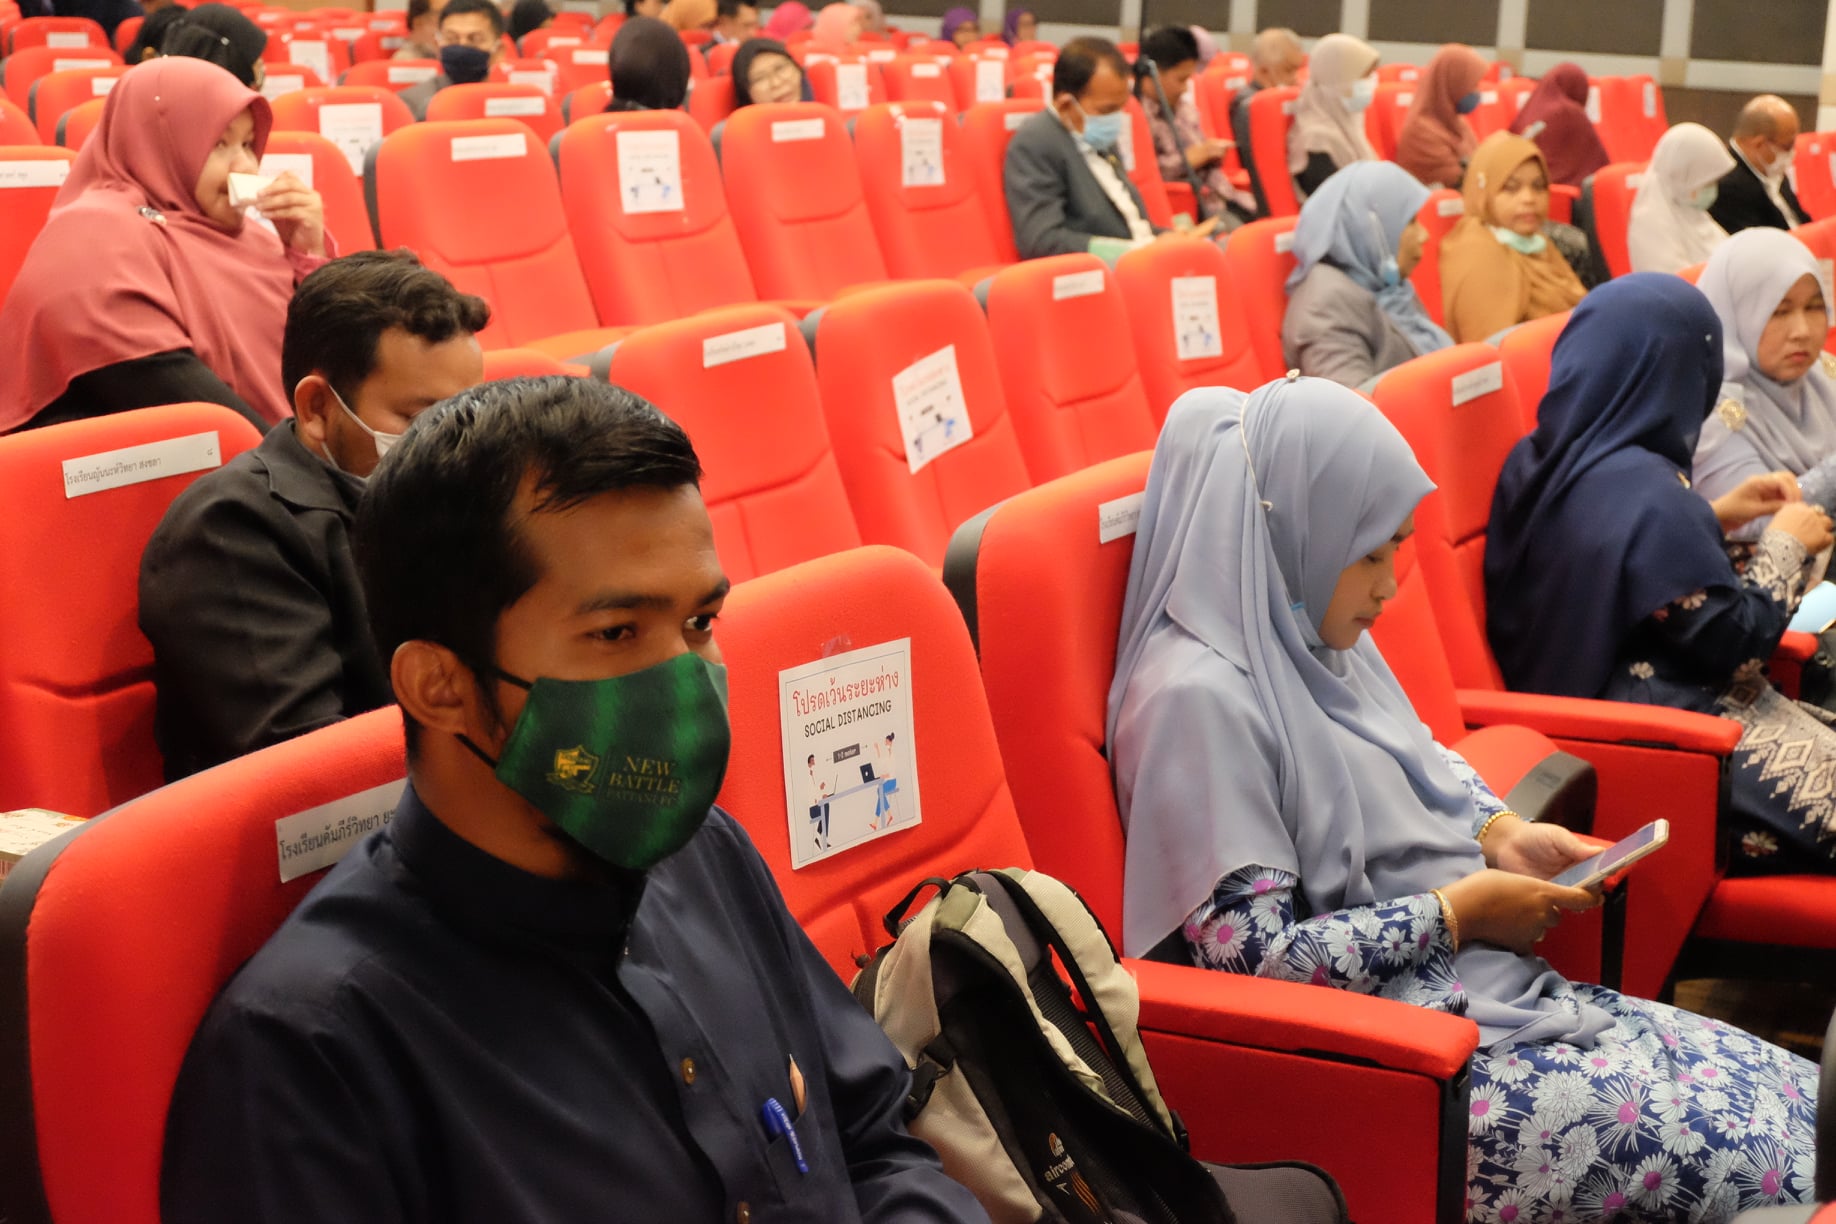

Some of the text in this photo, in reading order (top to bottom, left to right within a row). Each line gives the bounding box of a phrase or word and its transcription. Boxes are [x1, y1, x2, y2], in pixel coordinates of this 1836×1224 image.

[793, 664, 900, 717] โปรดเว้นระยะห่าง
[804, 699, 892, 738] SOCIAL DISTANCING
[623, 756, 677, 776] NEW
[609, 772, 681, 793] BATTLE
